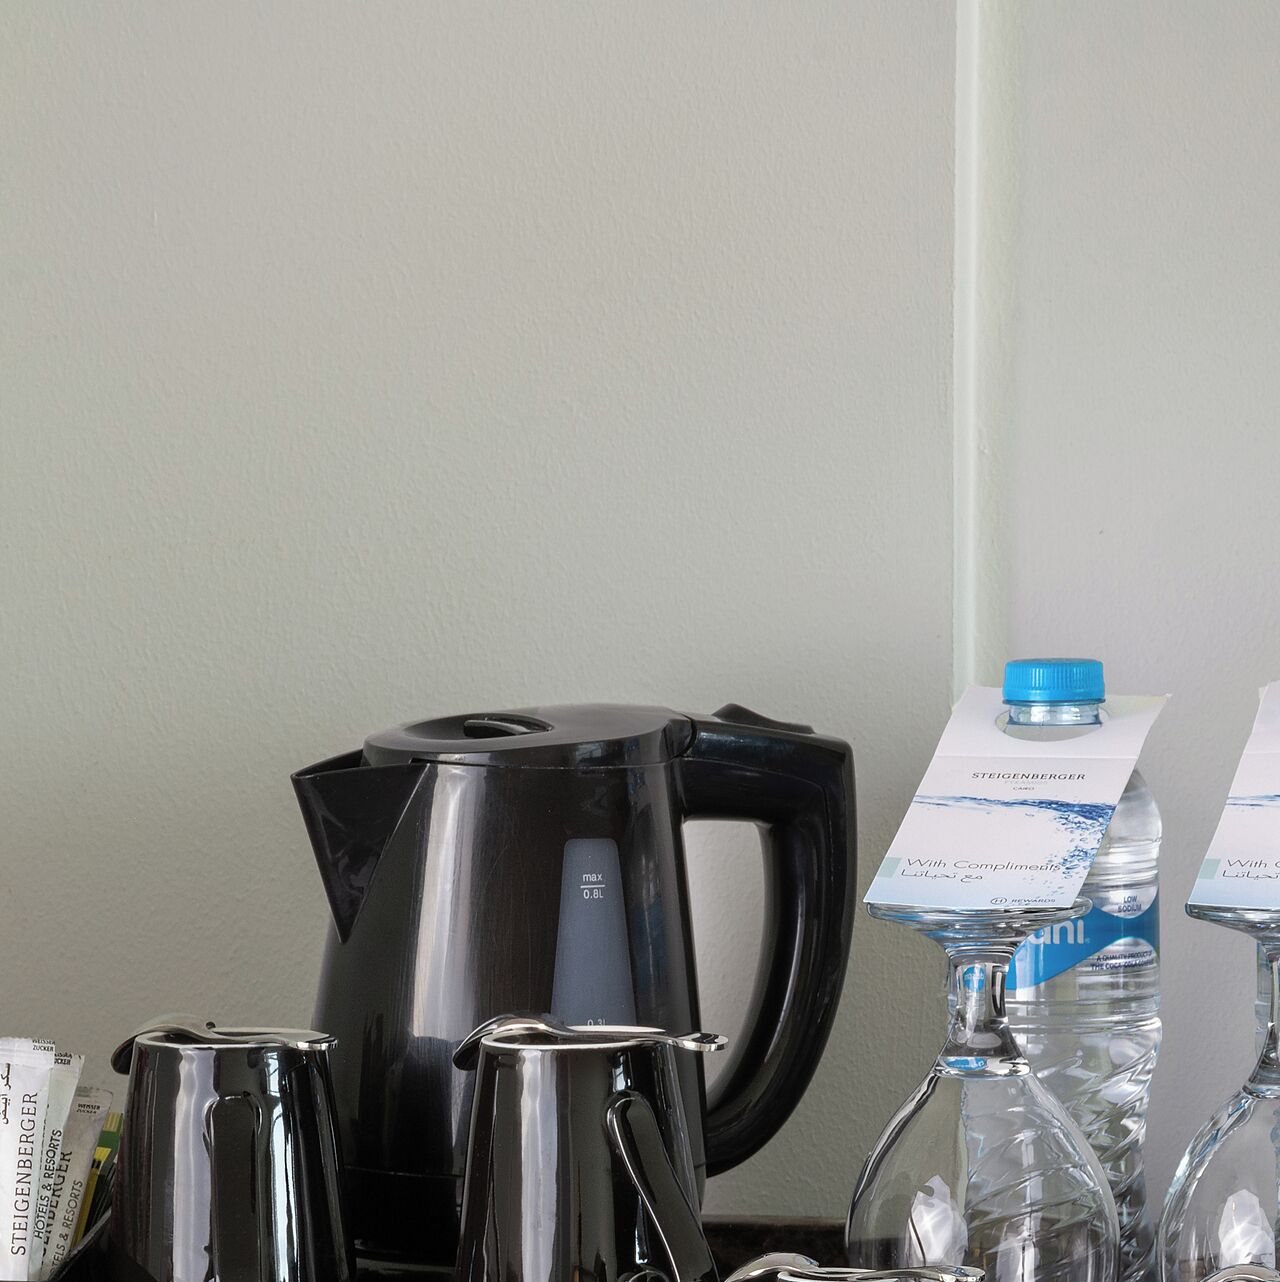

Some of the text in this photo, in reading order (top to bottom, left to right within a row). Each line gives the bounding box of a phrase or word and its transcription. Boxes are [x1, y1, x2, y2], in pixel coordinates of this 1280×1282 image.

[971, 772, 1086, 780] STEIGENBERGER
[907, 858, 1061, 872] With Compliments
[1227, 858, 1267, 868] With
[582, 873, 603, 882] max
[960, 874, 983, 883] مع
[583, 888, 604, 899] 0.8L
[1117, 904, 1142, 913] SODIUM
[1030, 919, 1085, 944] ani
[11, 1092, 38, 1256] STEIGENBERGER
[34, 1129, 62, 1239] HOTELS & RESORTS
[62, 1180, 83, 1229] RESORTS
[59, 1231, 69, 1241] &
